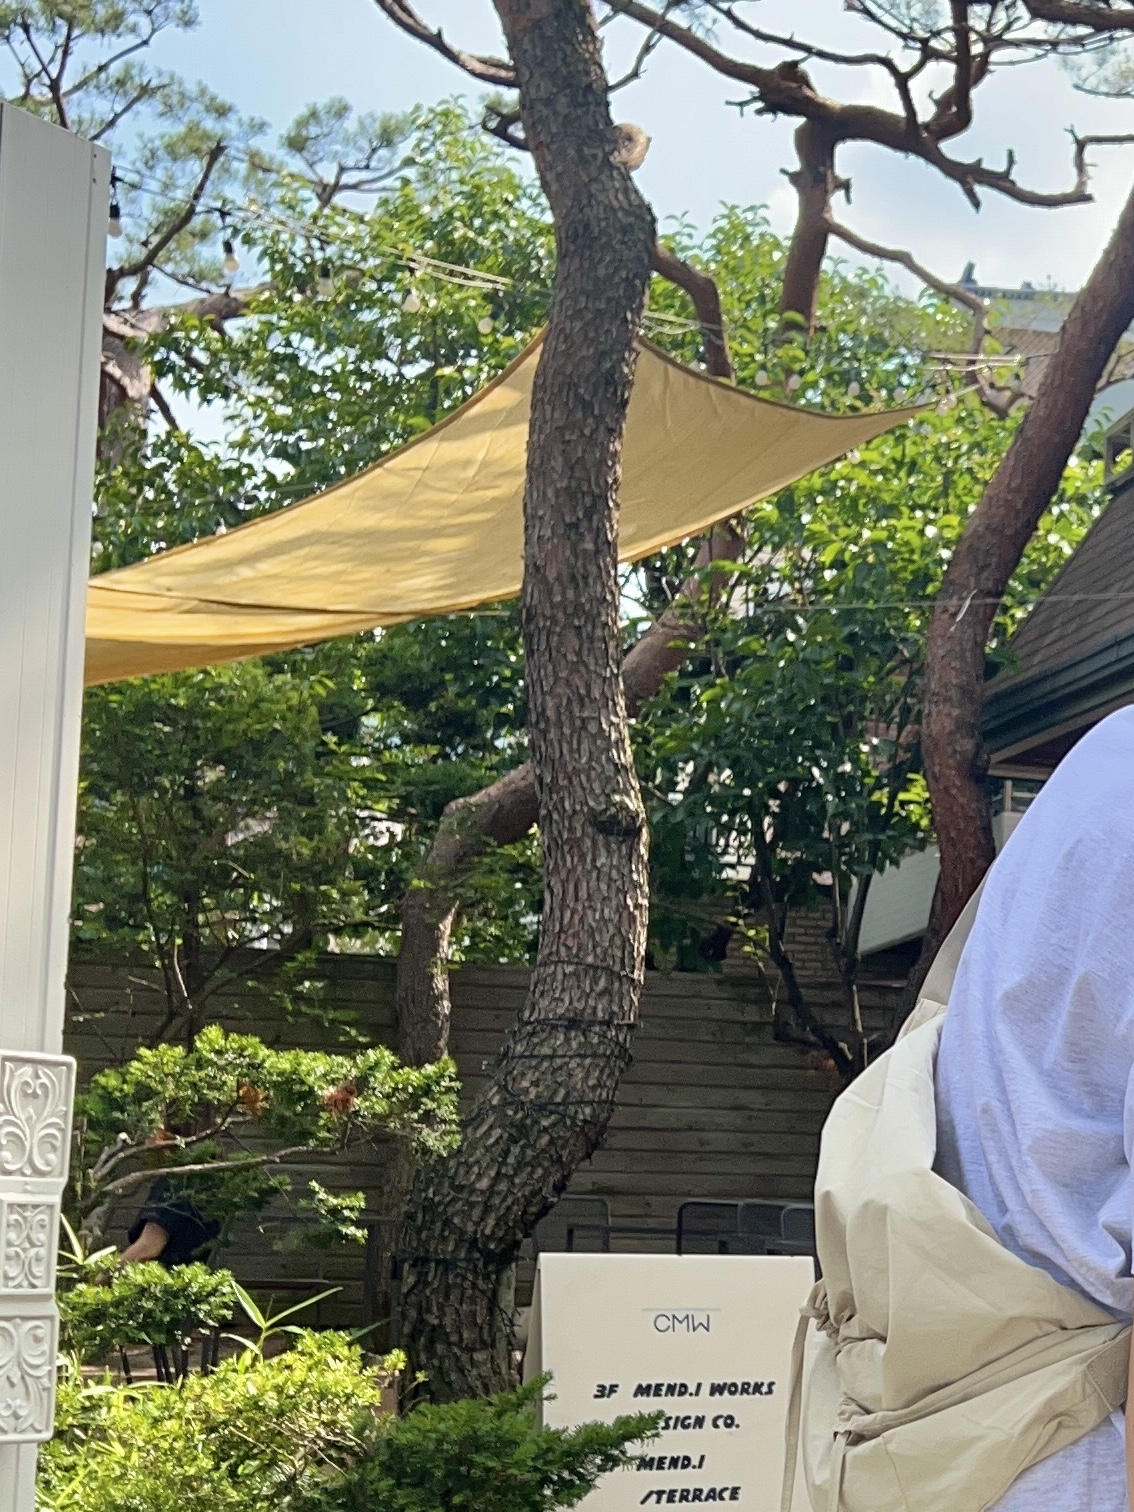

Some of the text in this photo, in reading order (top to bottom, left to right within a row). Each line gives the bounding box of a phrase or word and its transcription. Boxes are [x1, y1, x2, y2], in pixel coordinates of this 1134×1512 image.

[653, 1313, 711, 1333] CMW
[593, 1383, 620, 1399] 3F
[709, 1381, 776, 1397] WORKS
[642, 1414, 741, 1431] SIGN CO.
[640, 1486, 742, 1505] /TERRACE
